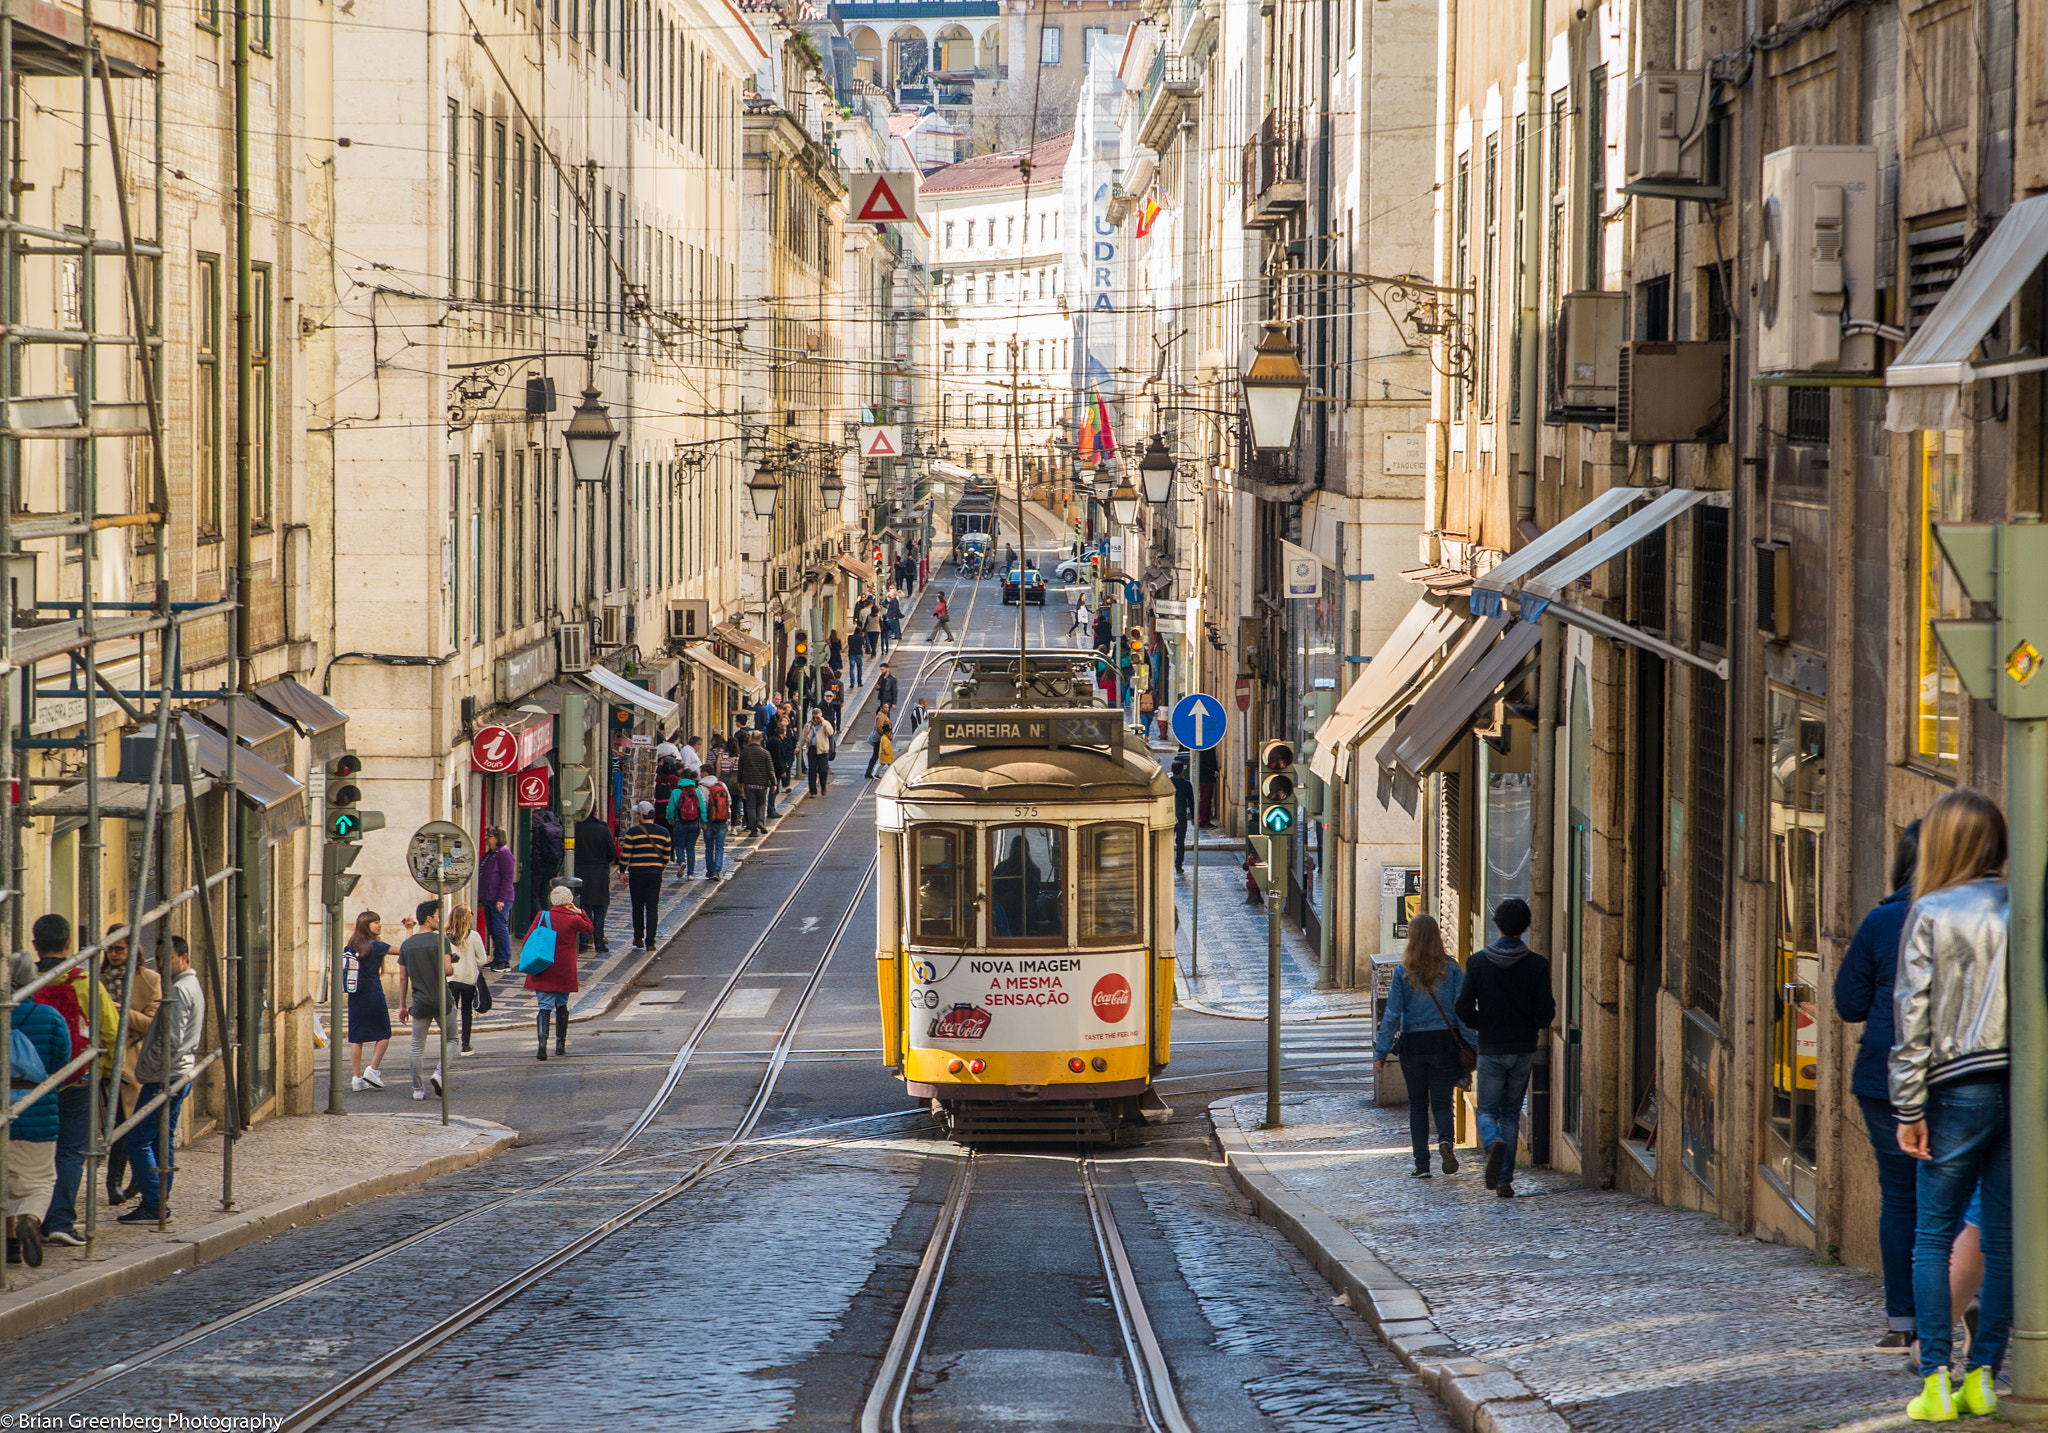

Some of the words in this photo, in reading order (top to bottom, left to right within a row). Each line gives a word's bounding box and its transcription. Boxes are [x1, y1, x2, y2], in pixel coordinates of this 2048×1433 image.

[945, 724, 1021, 739] CARREIRA
[1066, 720, 1099, 739] 28
[483, 760, 504, 768] tours
[1014, 807, 1038, 817] 575
[971, 961, 1014, 973] NOVA
[1020, 959, 1081, 973] IMAGEM
[990, 978, 1001, 989] A
[1006, 977, 1063, 989] MESMA
[985, 990, 1069, 1008] SENSAÇÃO
[1092, 990, 1129, 1007] Coca-Cola
[935, 1018, 985, 1037] Coca-Cola
